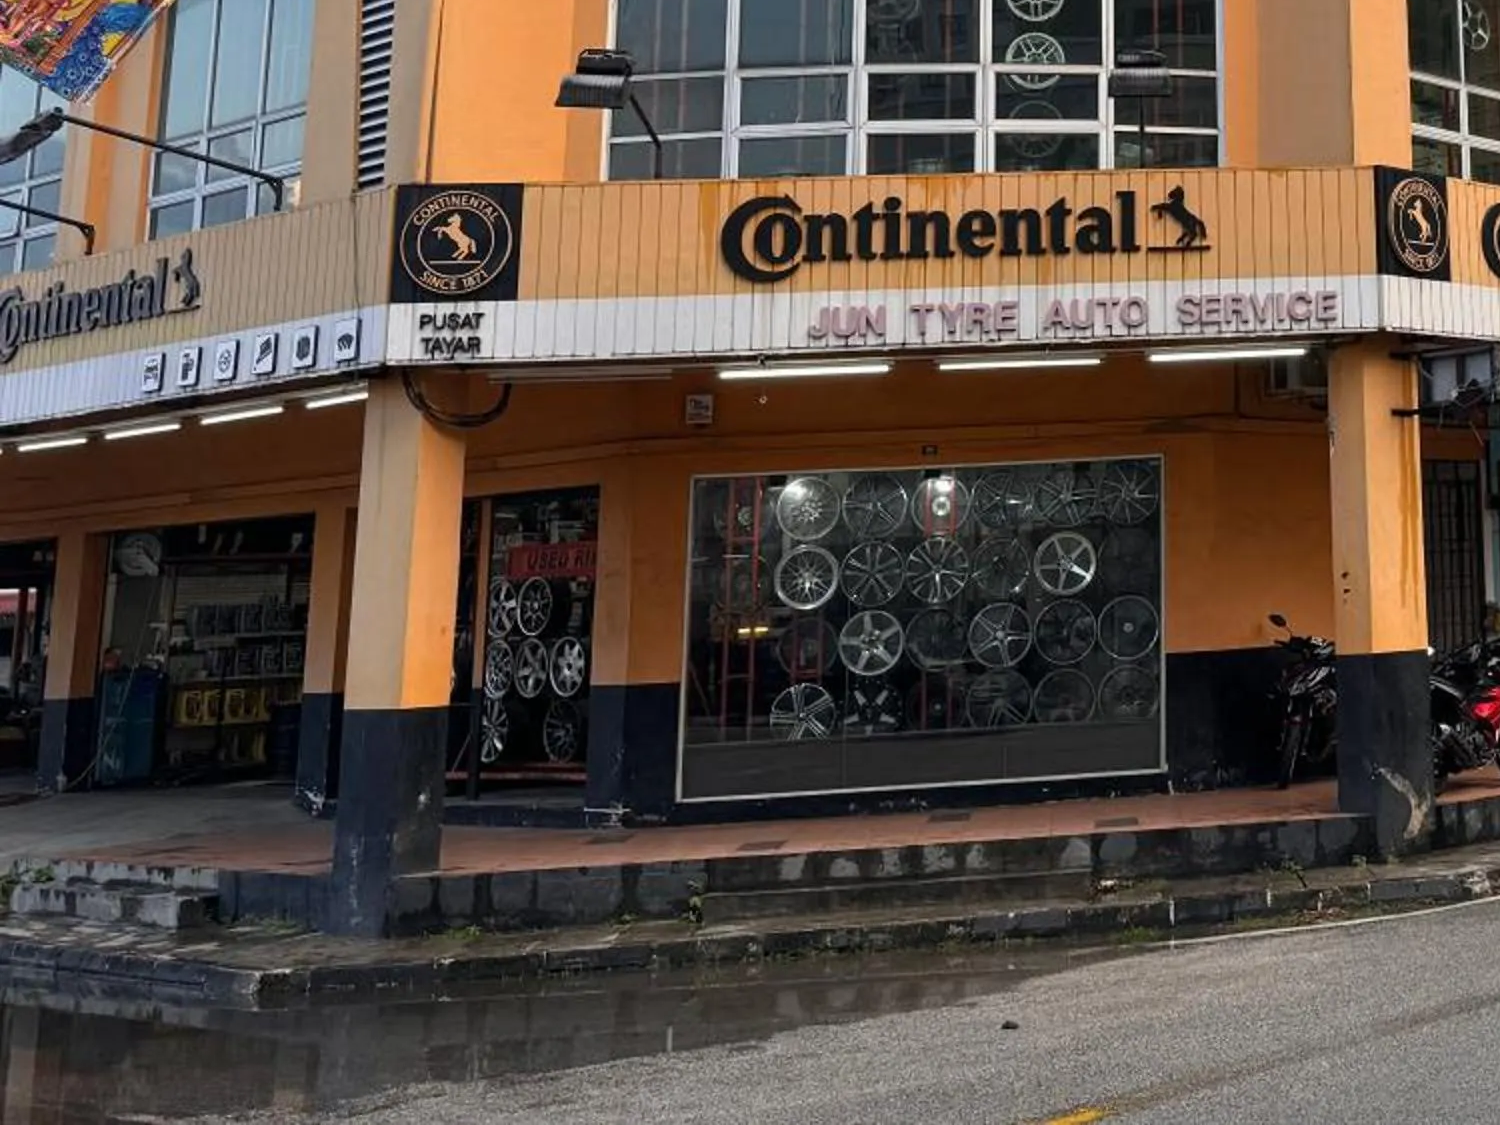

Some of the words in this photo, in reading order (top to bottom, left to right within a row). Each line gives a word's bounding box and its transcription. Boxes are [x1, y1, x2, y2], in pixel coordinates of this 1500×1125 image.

[413, 194, 499, 227] CONTINENTAL
[721, 191, 1139, 283] Continental
[420, 271, 457, 290] SINCE
[419, 312, 485, 331] PUSAT
[807, 304, 886, 340] JUN
[911, 300, 1018, 335] TYRE
[1043, 295, 1149, 330] AUTO
[1175, 290, 1338, 325] SERVICE
[421, 337, 481, 355] TAYAR
